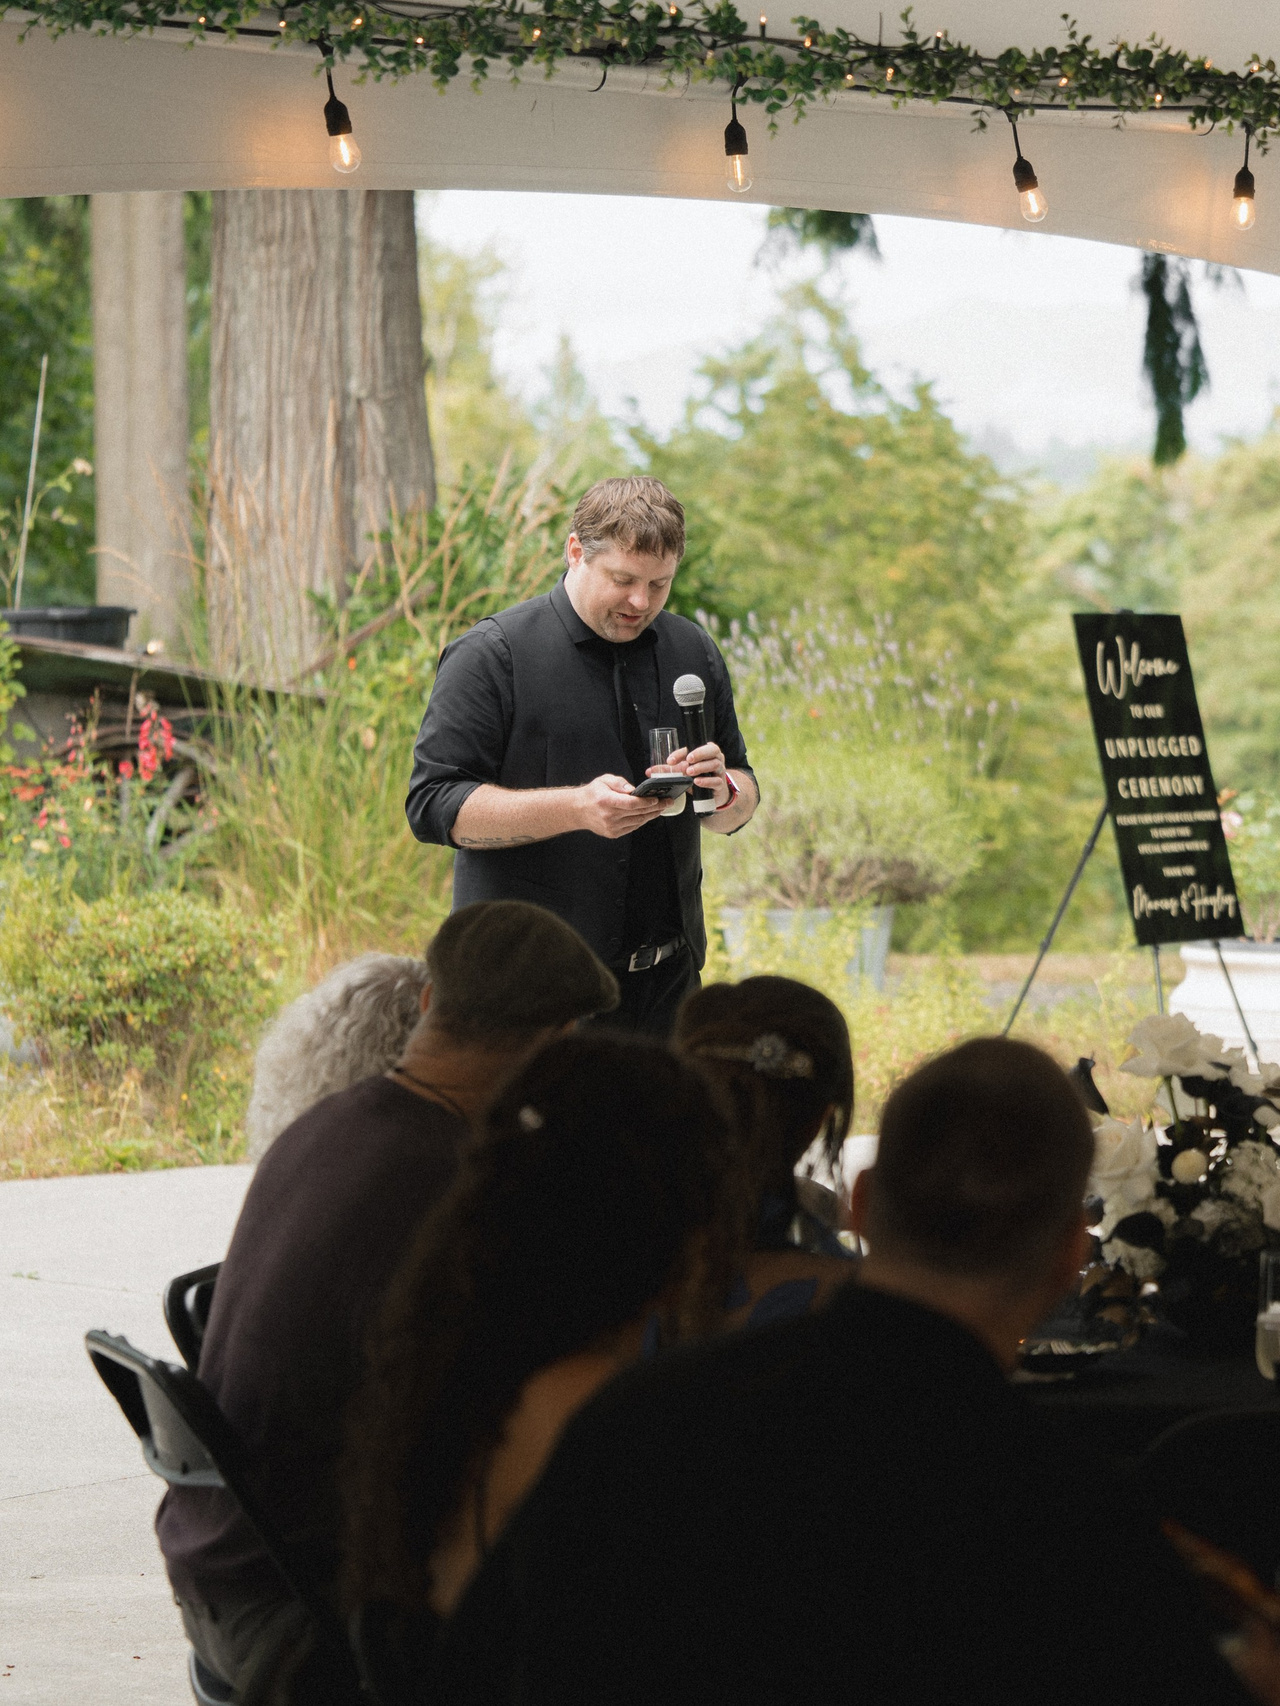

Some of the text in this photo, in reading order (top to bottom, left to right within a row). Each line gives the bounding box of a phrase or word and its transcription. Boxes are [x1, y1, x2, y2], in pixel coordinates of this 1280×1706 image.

[1096, 635, 1180, 699] Welcome
[1129, 703, 1165, 719] TO OUR
[1104, 735, 1202, 759] UNPLUGGED
[1117, 775, 1204, 799] CEREMONY
